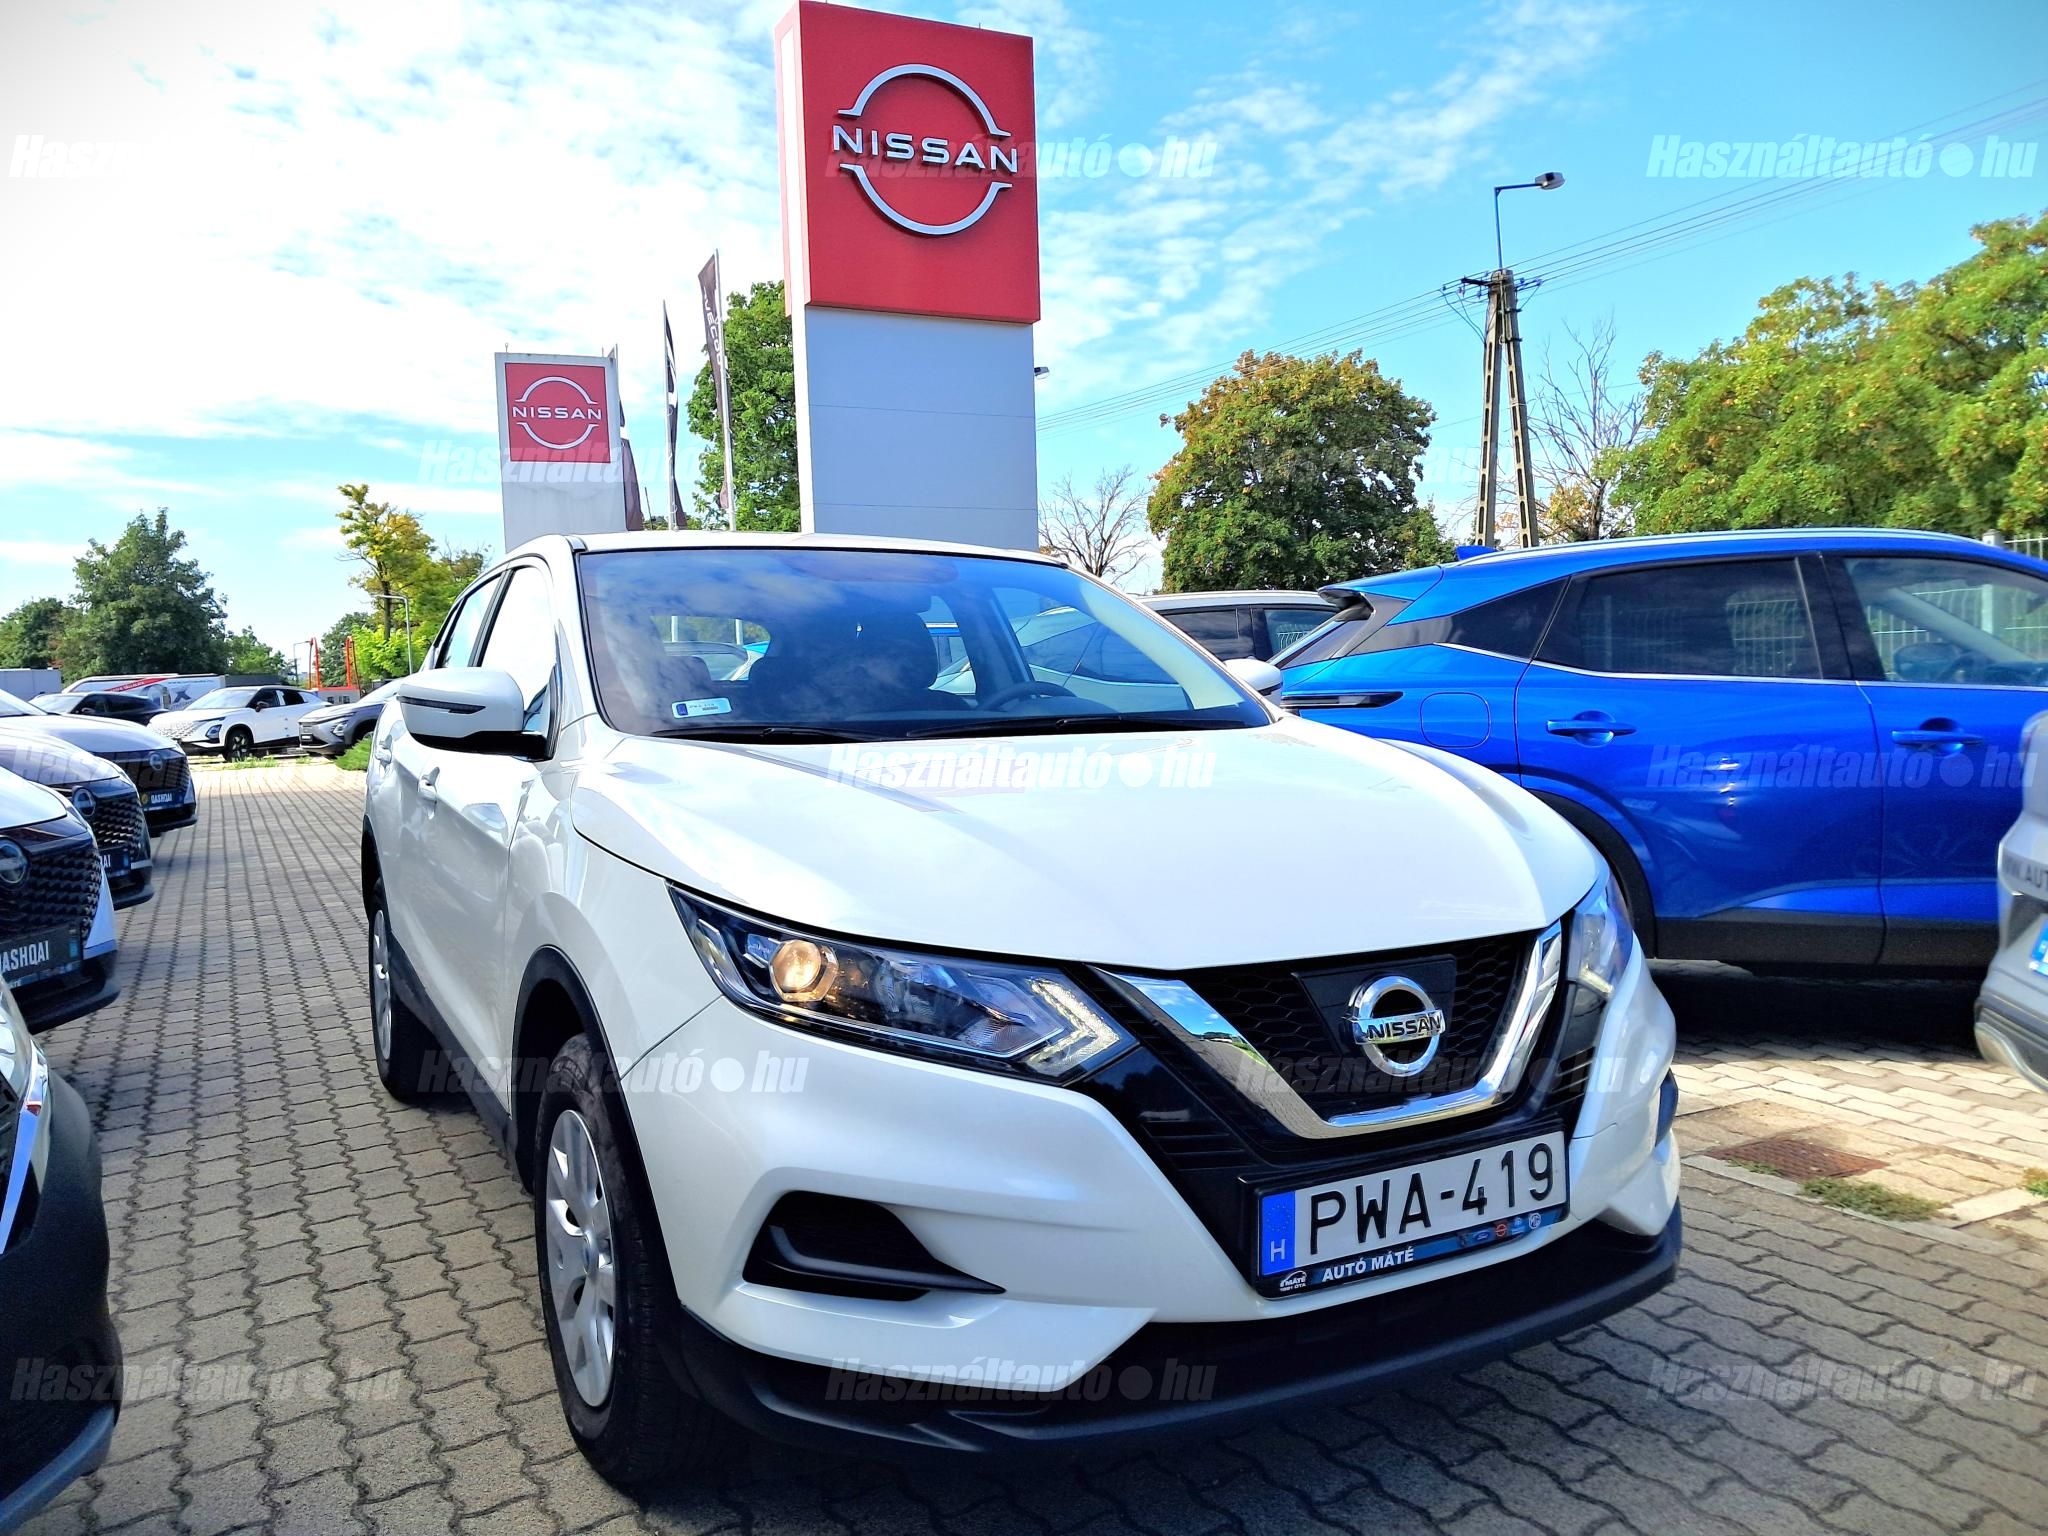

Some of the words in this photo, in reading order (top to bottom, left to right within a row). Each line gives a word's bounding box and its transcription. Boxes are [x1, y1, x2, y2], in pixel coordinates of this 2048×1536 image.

[832, 125, 1018, 173] NISSAN
[512, 406, 602, 420] NISSAN
[0, 940, 49, 972] ASHQAI
[1367, 1015, 1441, 1039] NISSAN
[1310, 1143, 1553, 1255] PWA-419
[1270, 1238, 1286, 1263] H
[1322, 1258, 1367, 1283] AUTÓ
[1371, 1246, 1415, 1270] MÁTÉ
